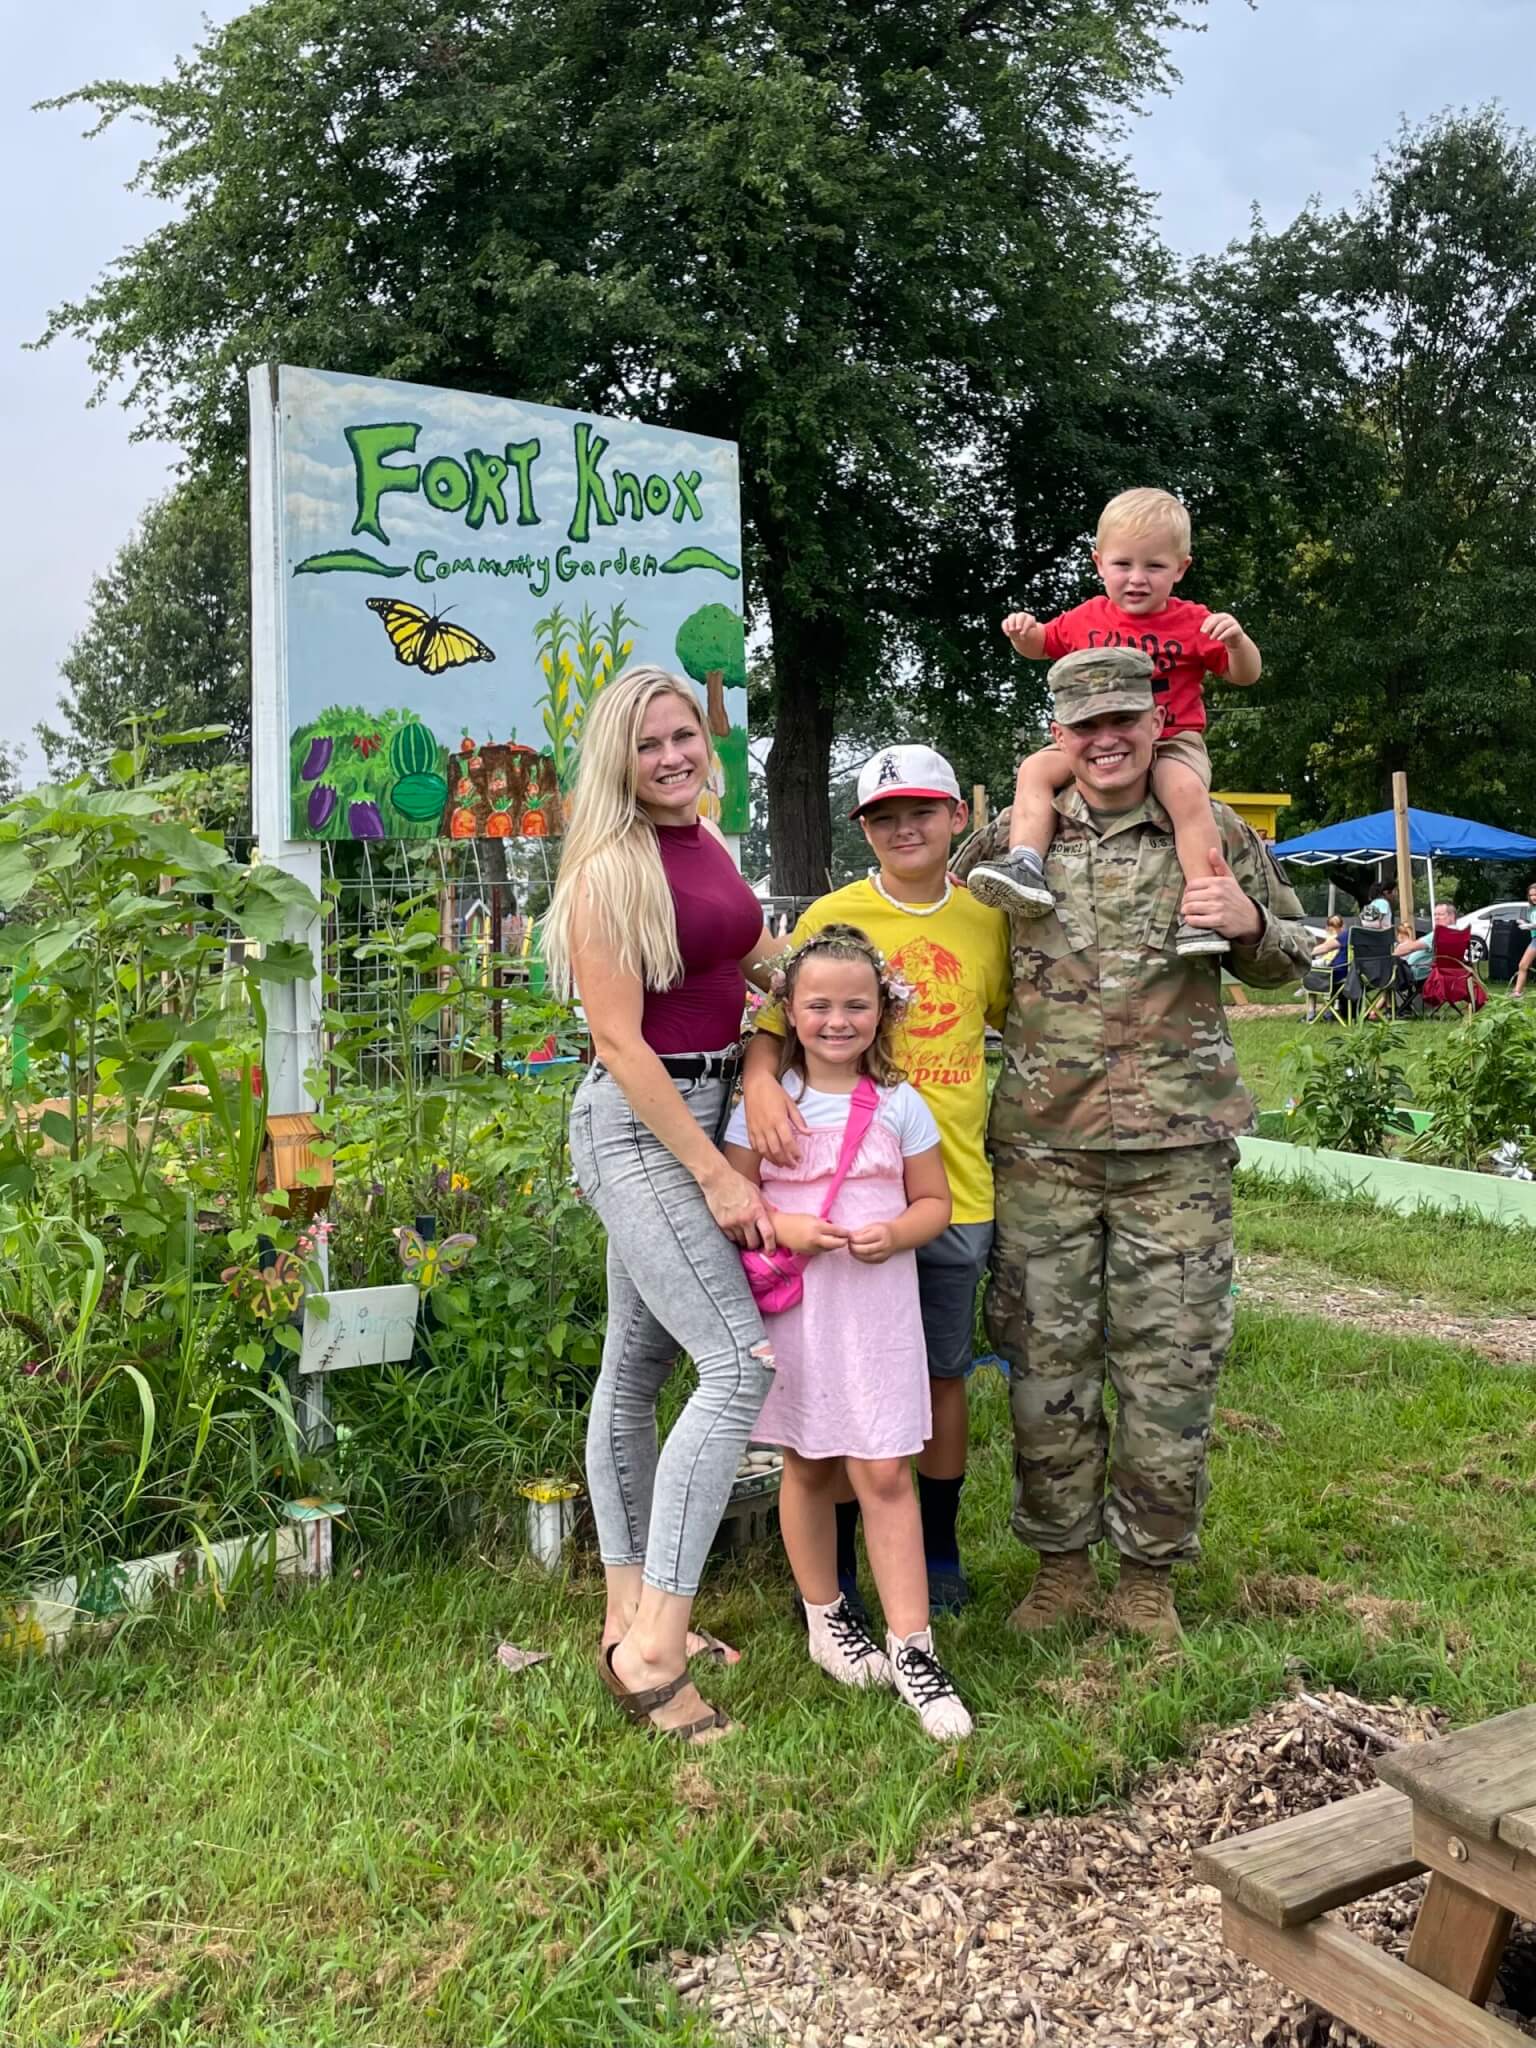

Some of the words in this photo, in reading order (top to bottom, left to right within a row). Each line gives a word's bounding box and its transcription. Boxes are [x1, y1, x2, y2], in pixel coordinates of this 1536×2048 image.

[567, 422, 704, 543] Knox
[414, 549, 550, 598] Community
[555, 545, 657, 582] Garden
